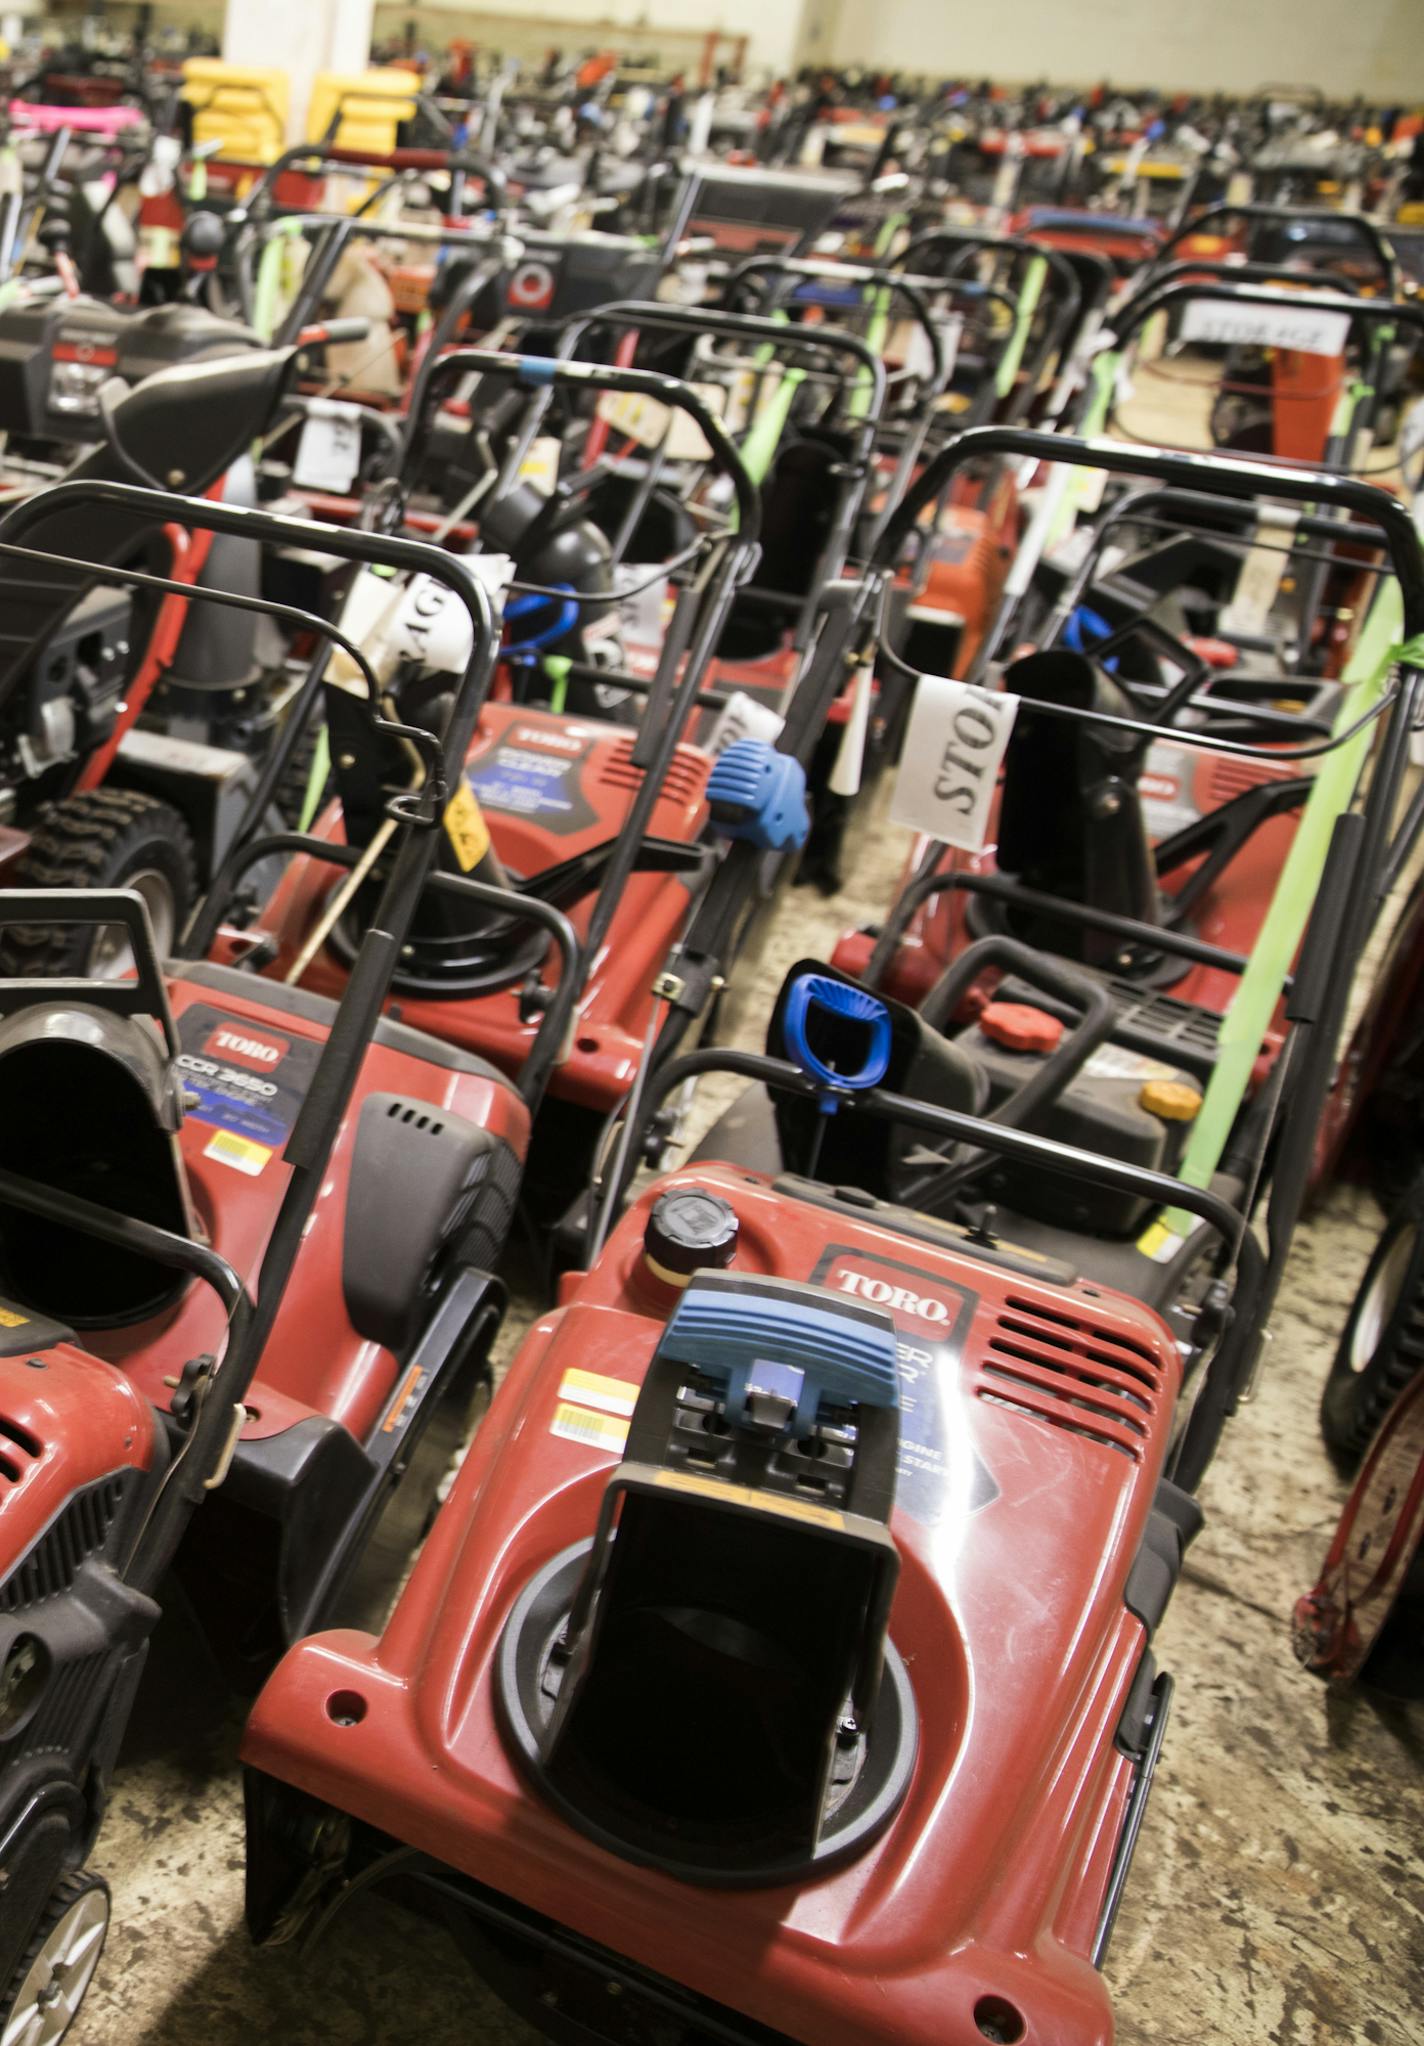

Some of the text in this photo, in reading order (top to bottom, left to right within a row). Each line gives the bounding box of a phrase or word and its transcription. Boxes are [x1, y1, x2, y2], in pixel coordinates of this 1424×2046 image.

[216, 1030, 279, 1062] TORO
[175, 1053, 219, 1077] CCR
[836, 1268, 949, 1322] TORO
